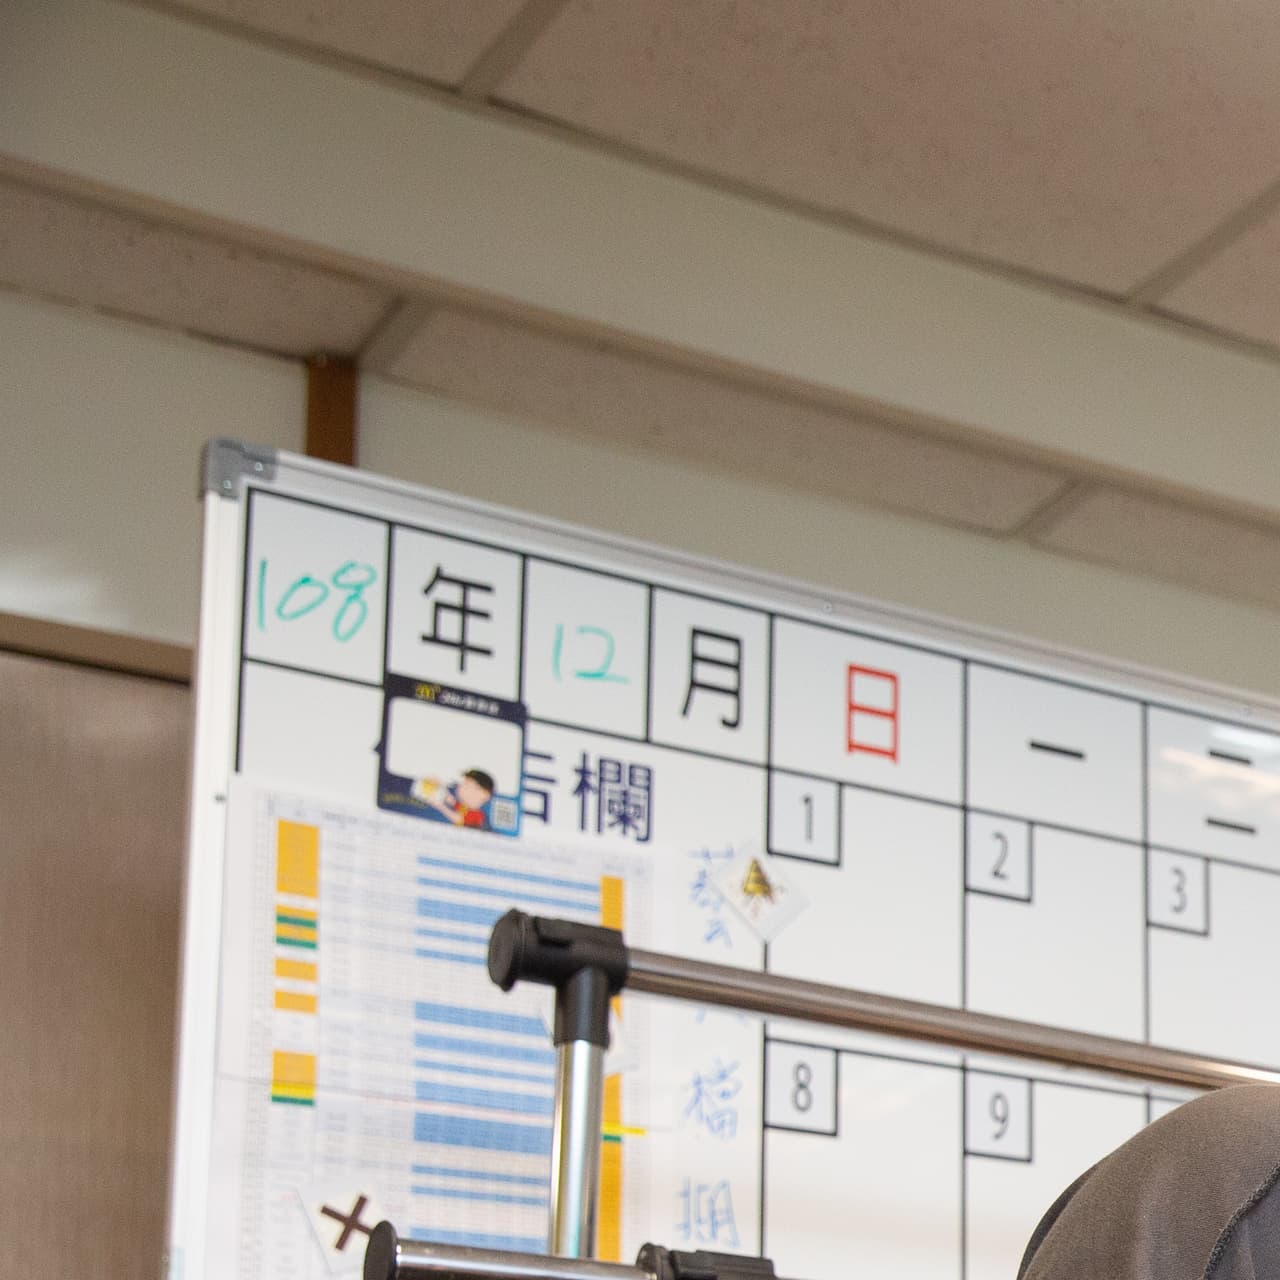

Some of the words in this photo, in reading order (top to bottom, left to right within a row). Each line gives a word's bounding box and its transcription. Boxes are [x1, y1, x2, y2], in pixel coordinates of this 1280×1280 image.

[256, 558, 377, 643] 108
[420, 564, 496, 673] 年
[550, 622, 631, 685] 12
[681, 626, 743, 730] 月
[846, 662, 899, 764] 日
[800, 795, 814, 843] 1
[990, 832, 1011, 882] 2
[1169, 867, 1188, 915] 3
[789, 1062, 815, 1113] 8
[989, 1092, 1010, 1142] 9
